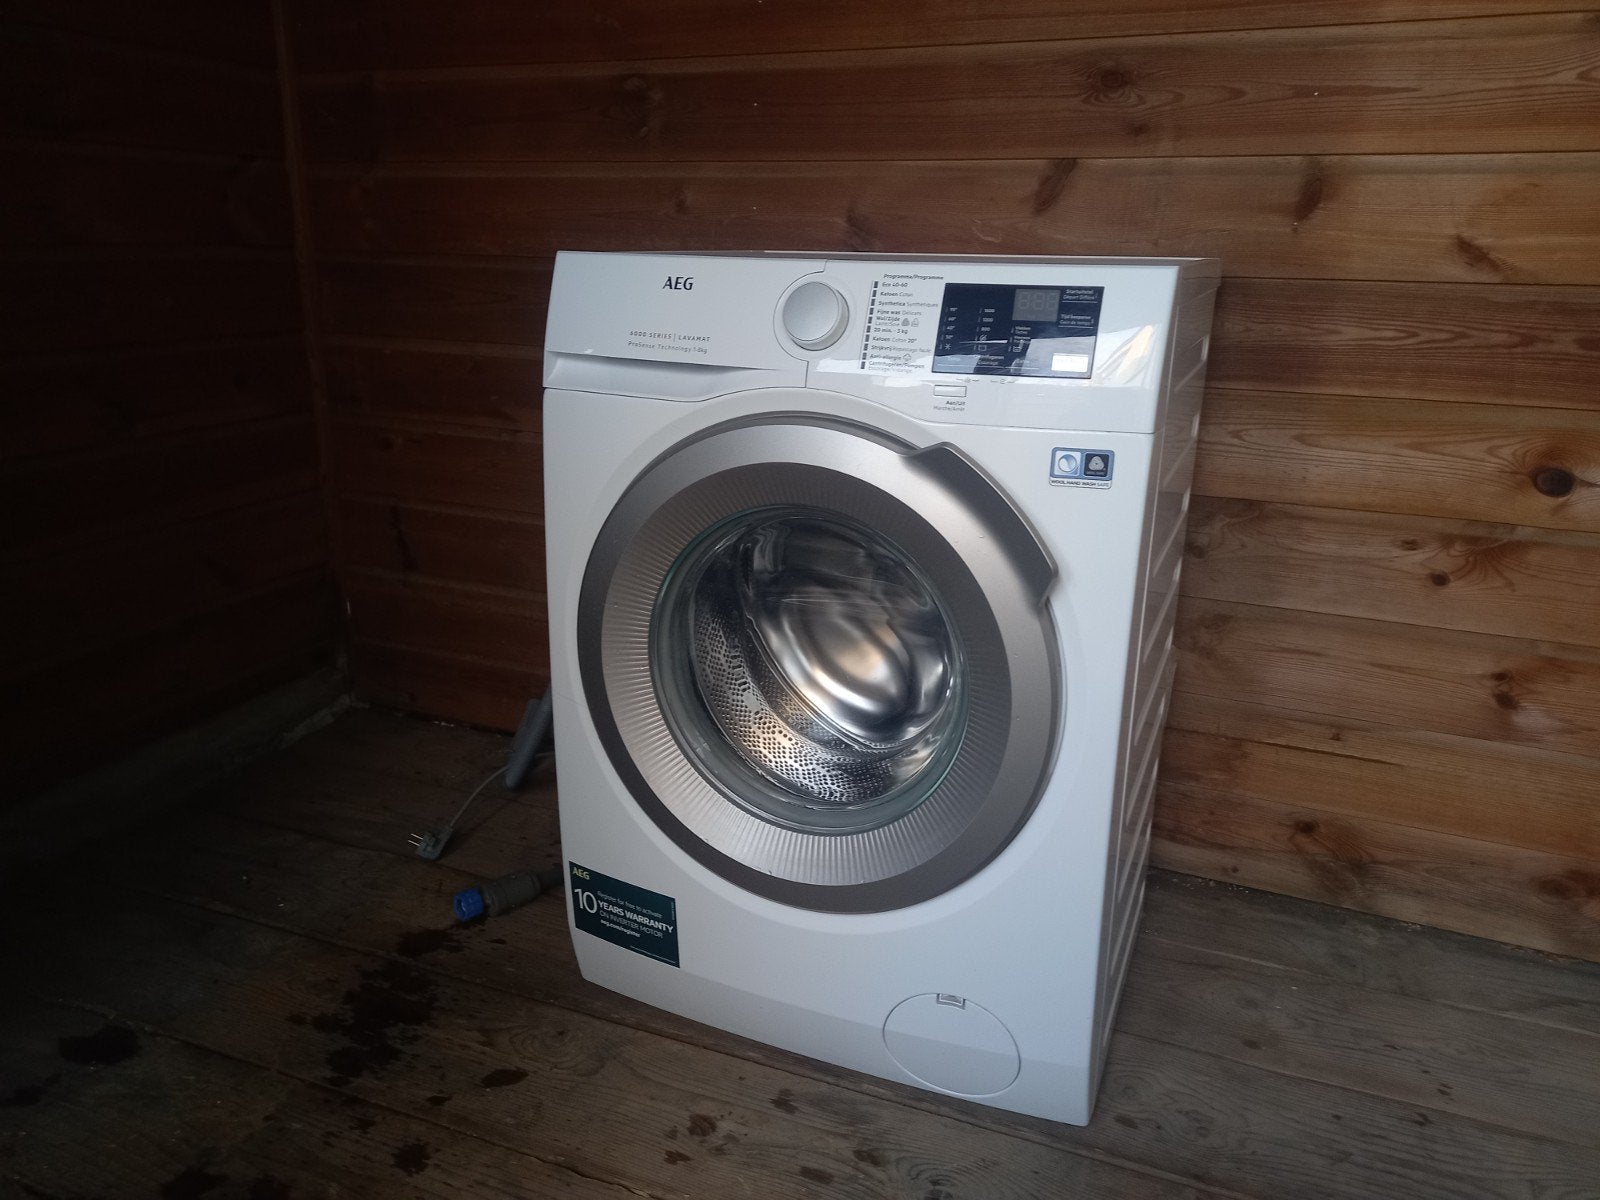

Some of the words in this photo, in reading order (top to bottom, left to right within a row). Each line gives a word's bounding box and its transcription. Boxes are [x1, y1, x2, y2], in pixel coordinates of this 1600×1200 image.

[662, 276, 694, 291] AEG
[627, 341, 656, 349] ProSense
[657, 344, 692, 353] Technology
[572, 867, 590, 880] AEG
[574, 888, 598, 914] 10
[598, 900, 625, 917] YEARS
[624, 910, 674, 934] WARRANTY
[609, 913, 640, 931] INVERTER
[639, 924, 664, 939] MOTOR
